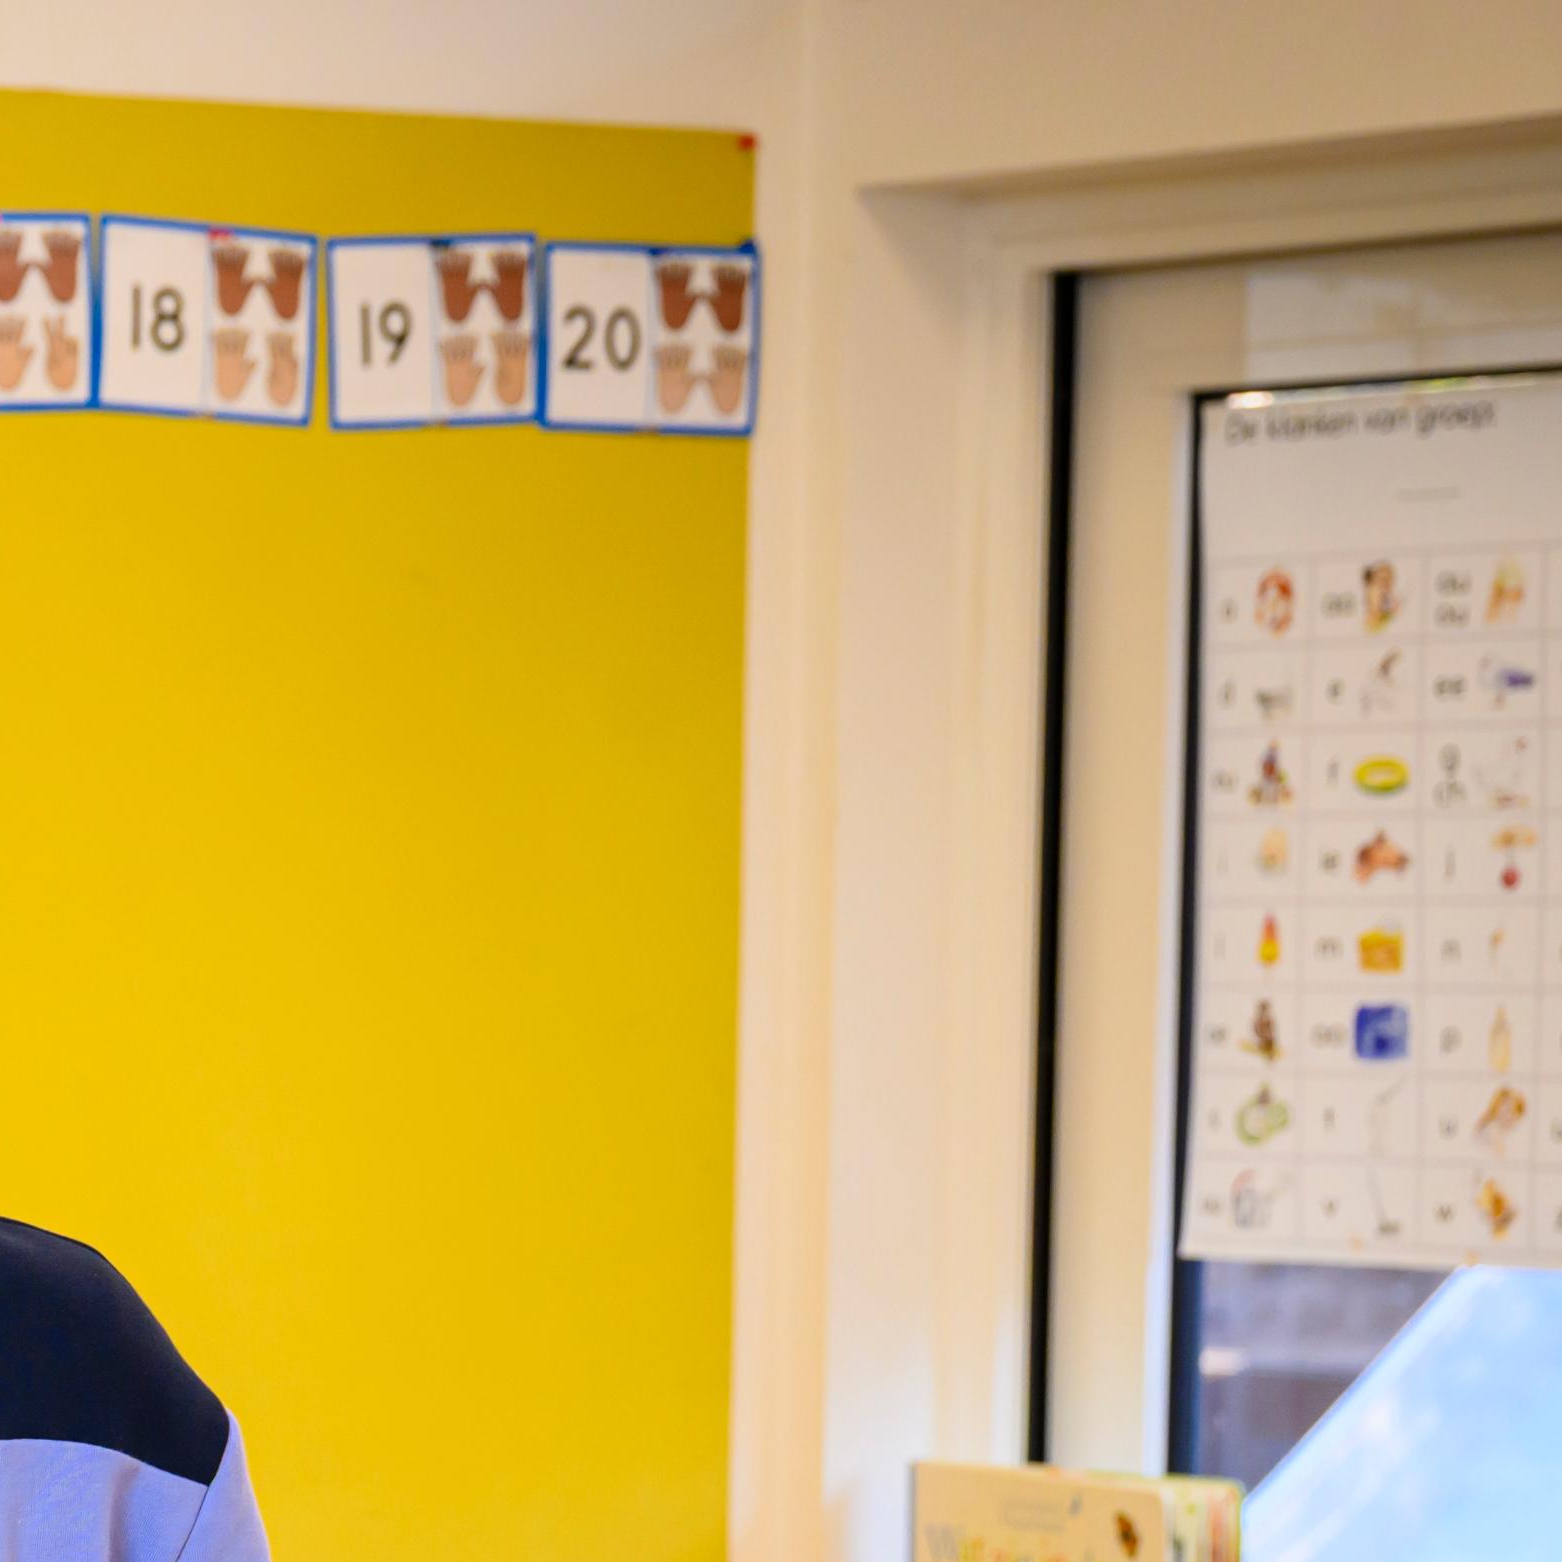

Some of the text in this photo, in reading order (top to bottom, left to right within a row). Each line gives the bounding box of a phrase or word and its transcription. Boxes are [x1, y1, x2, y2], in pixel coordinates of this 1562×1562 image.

[131, 286, 185, 354] 18
[360, 301, 412, 365] 19
[562, 305, 641, 372] 20
